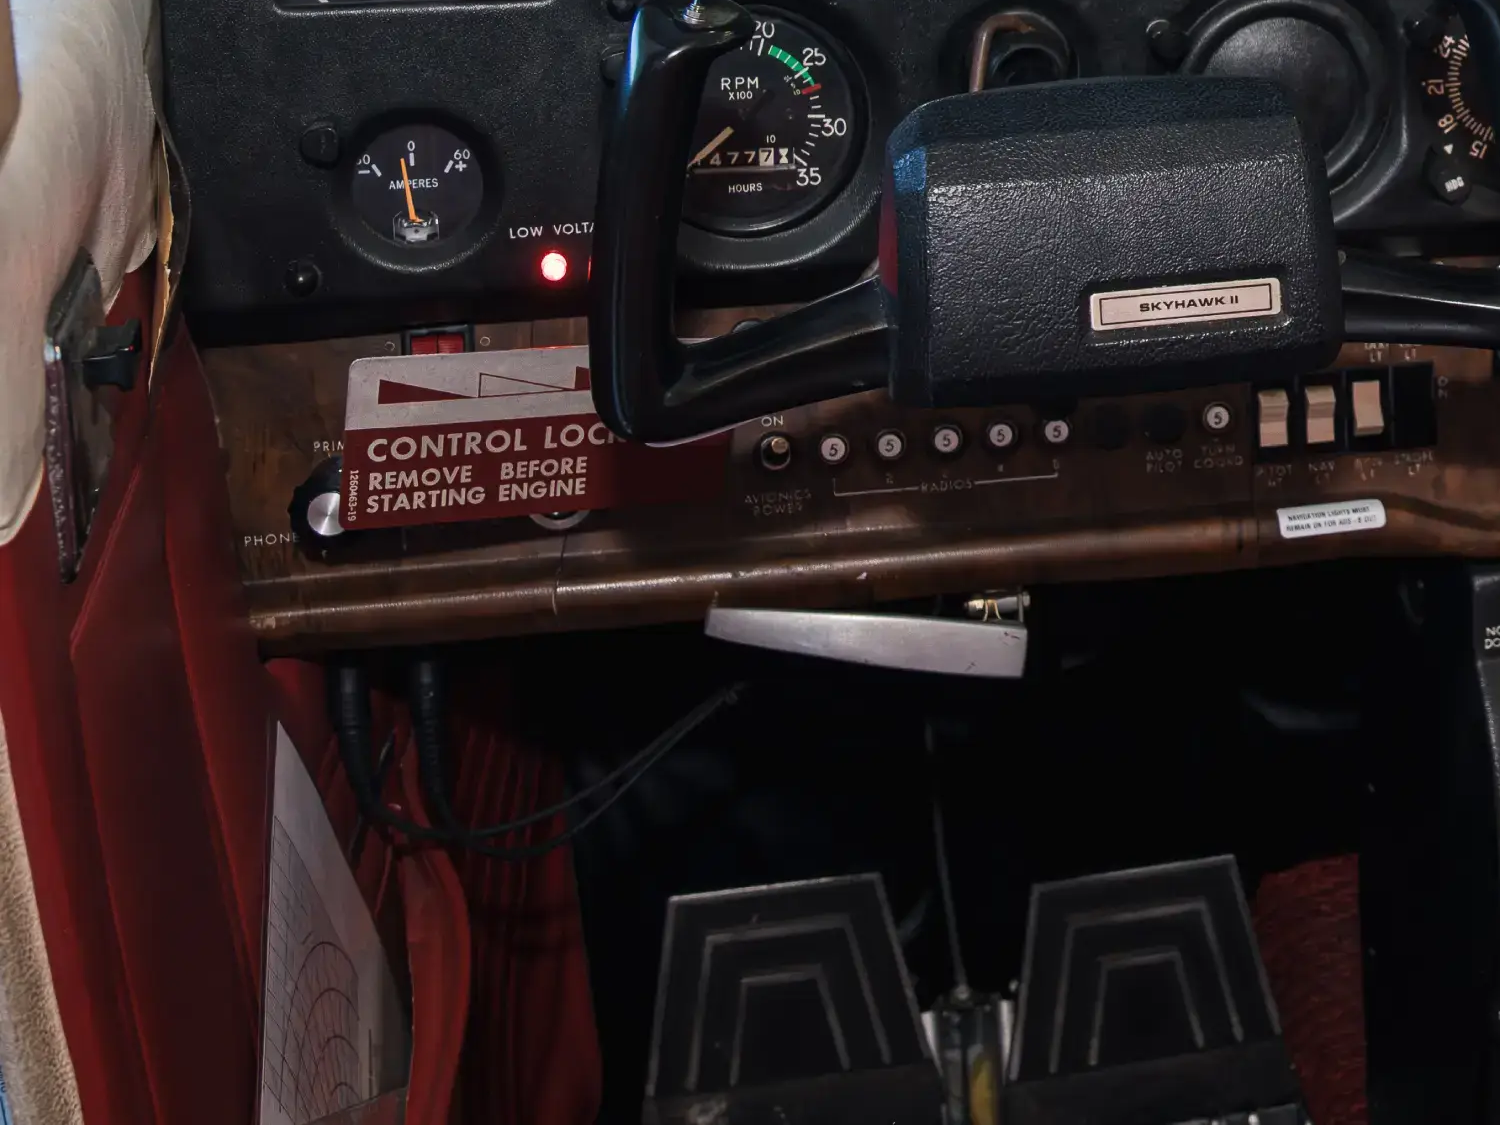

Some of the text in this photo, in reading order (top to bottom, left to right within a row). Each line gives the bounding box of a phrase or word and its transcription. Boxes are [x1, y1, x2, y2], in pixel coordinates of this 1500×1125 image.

[802, 48, 827, 65] 25
[721, 77, 760, 89] RPM
[821, 118, 847, 136] 30
[388, 178, 439, 190] AMPERES
[796, 168, 822, 186] 35
[728, 183, 763, 193] HOURS
[509, 226, 543, 239] LOW
[1139, 295, 1239, 313] SKYHAWK II
[761, 415, 784, 427] ON
[367, 428, 527, 463] CONTROL
[1145, 448, 1182, 462] AUTO
[368, 456, 588, 491] REMOVE BEFORE
[1146, 461, 1183, 473] PILOT
[920, 479, 974, 494] RADIOS
[347, 469, 359, 522] 1260463-19
[366, 478, 587, 514] STARTING ENGINE
[744, 489, 812, 505] AVIONICS
[1288, 511, 1326, 522] NAVIGATION
[1328, 508, 1350, 518] LIGHTS
[1286, 522, 1311, 532] REMAIN
[1324, 518, 1336, 528] FOR
